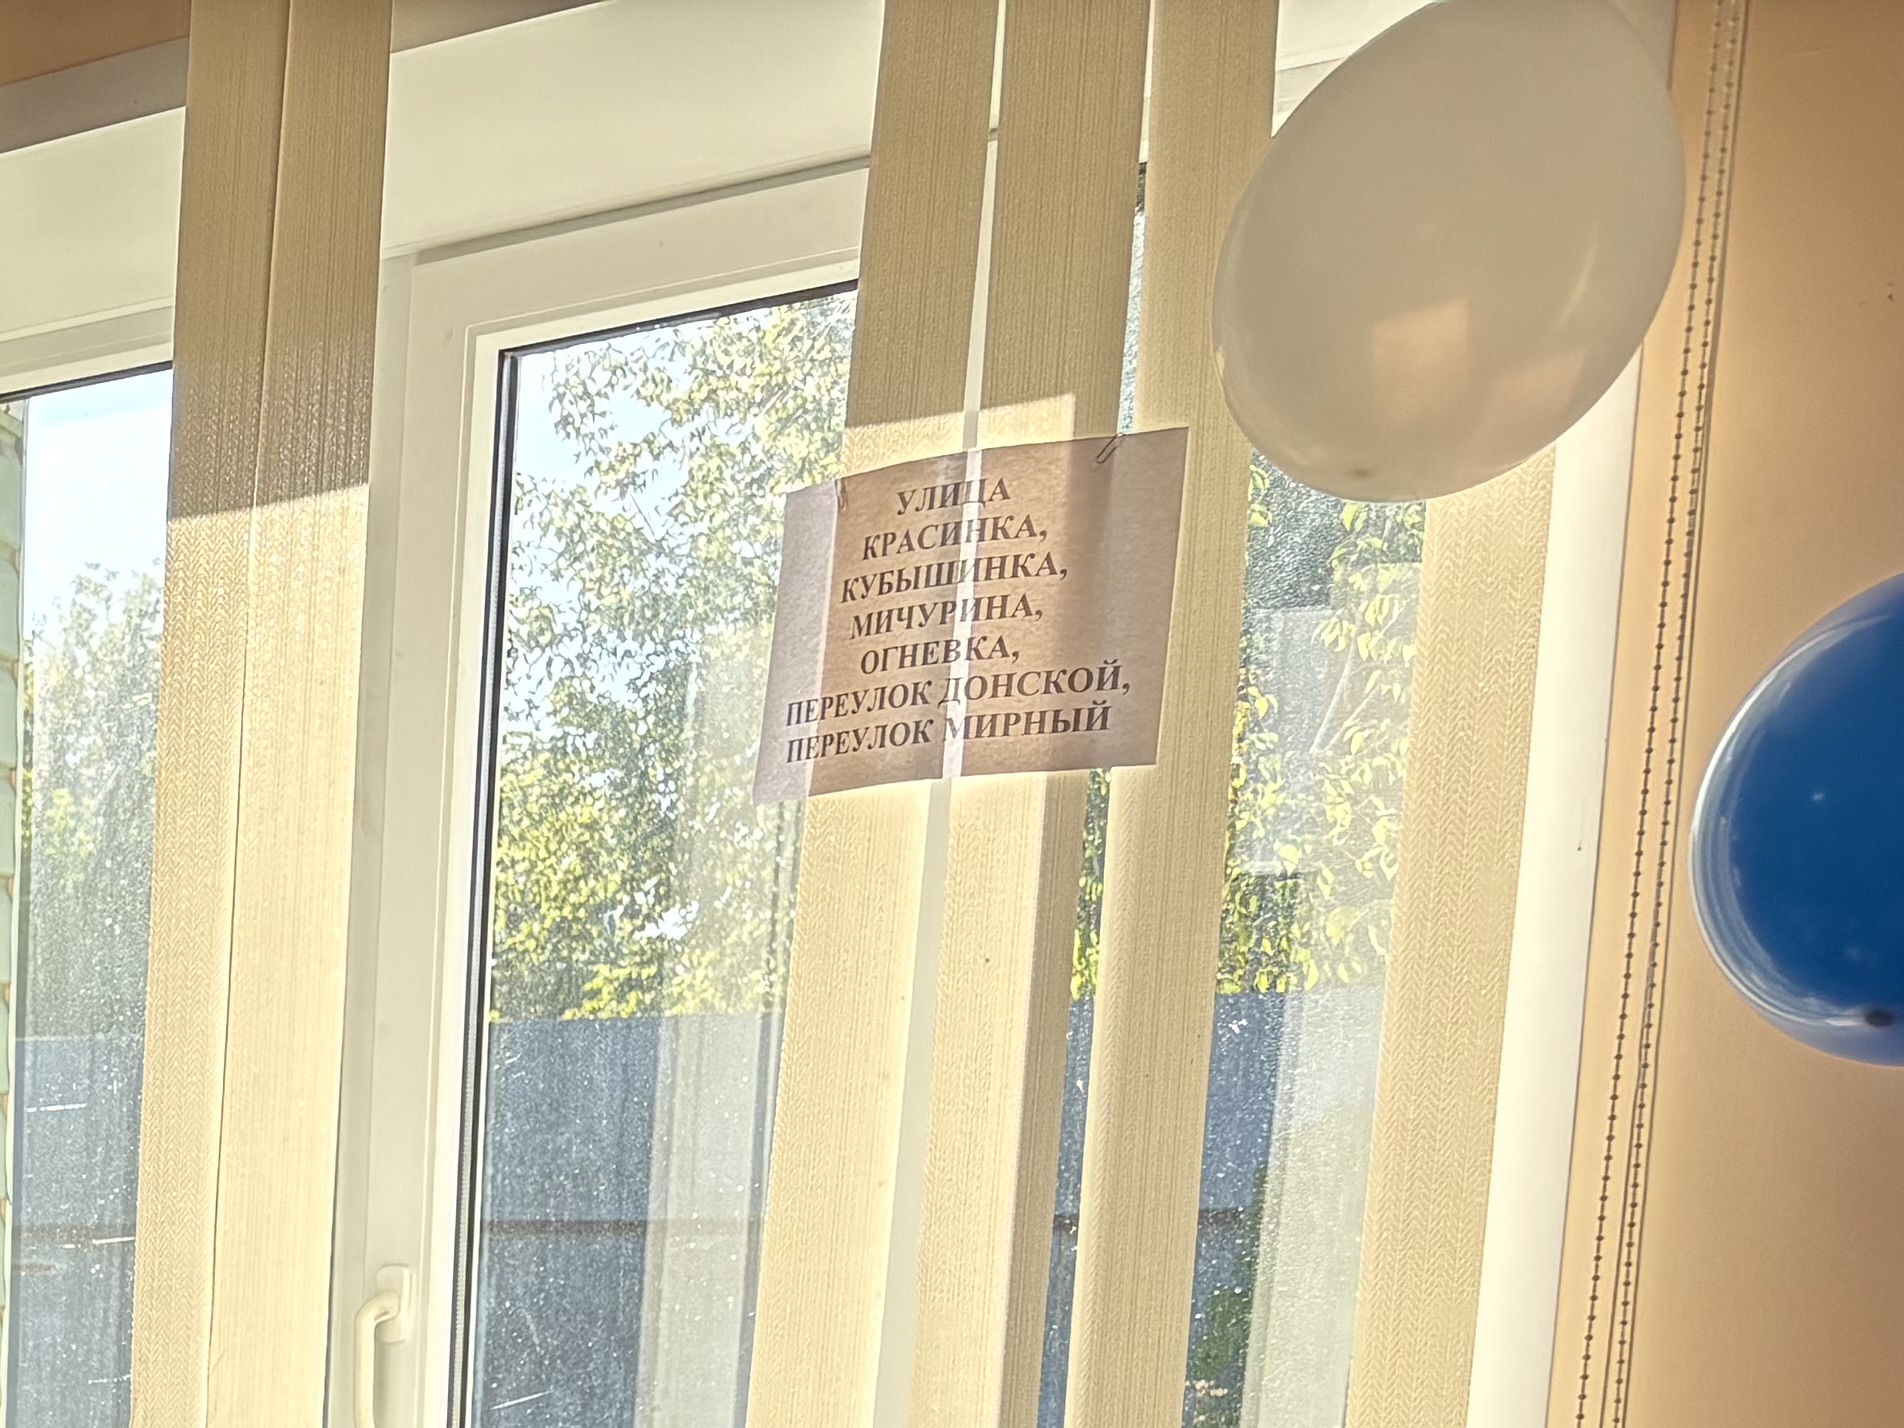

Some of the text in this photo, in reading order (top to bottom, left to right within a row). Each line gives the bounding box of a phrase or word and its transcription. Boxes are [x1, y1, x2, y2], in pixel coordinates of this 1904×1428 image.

[896, 477, 1011, 516] УЛИЦА
[861, 513, 1048, 561] КРАСИНКА,
[840, 551, 1068, 604] КУБЫШИНКА,
[849, 593, 1044, 640] МИЧУРИНА,
[860, 634, 1021, 676] ОГНЕВКА,
[785, 658, 1131, 727] ПЕРЕУЛОК ДОНСКОЙ,
[786, 700, 1112, 764] ПЕРЕУЛОК МИРНЫЙ
